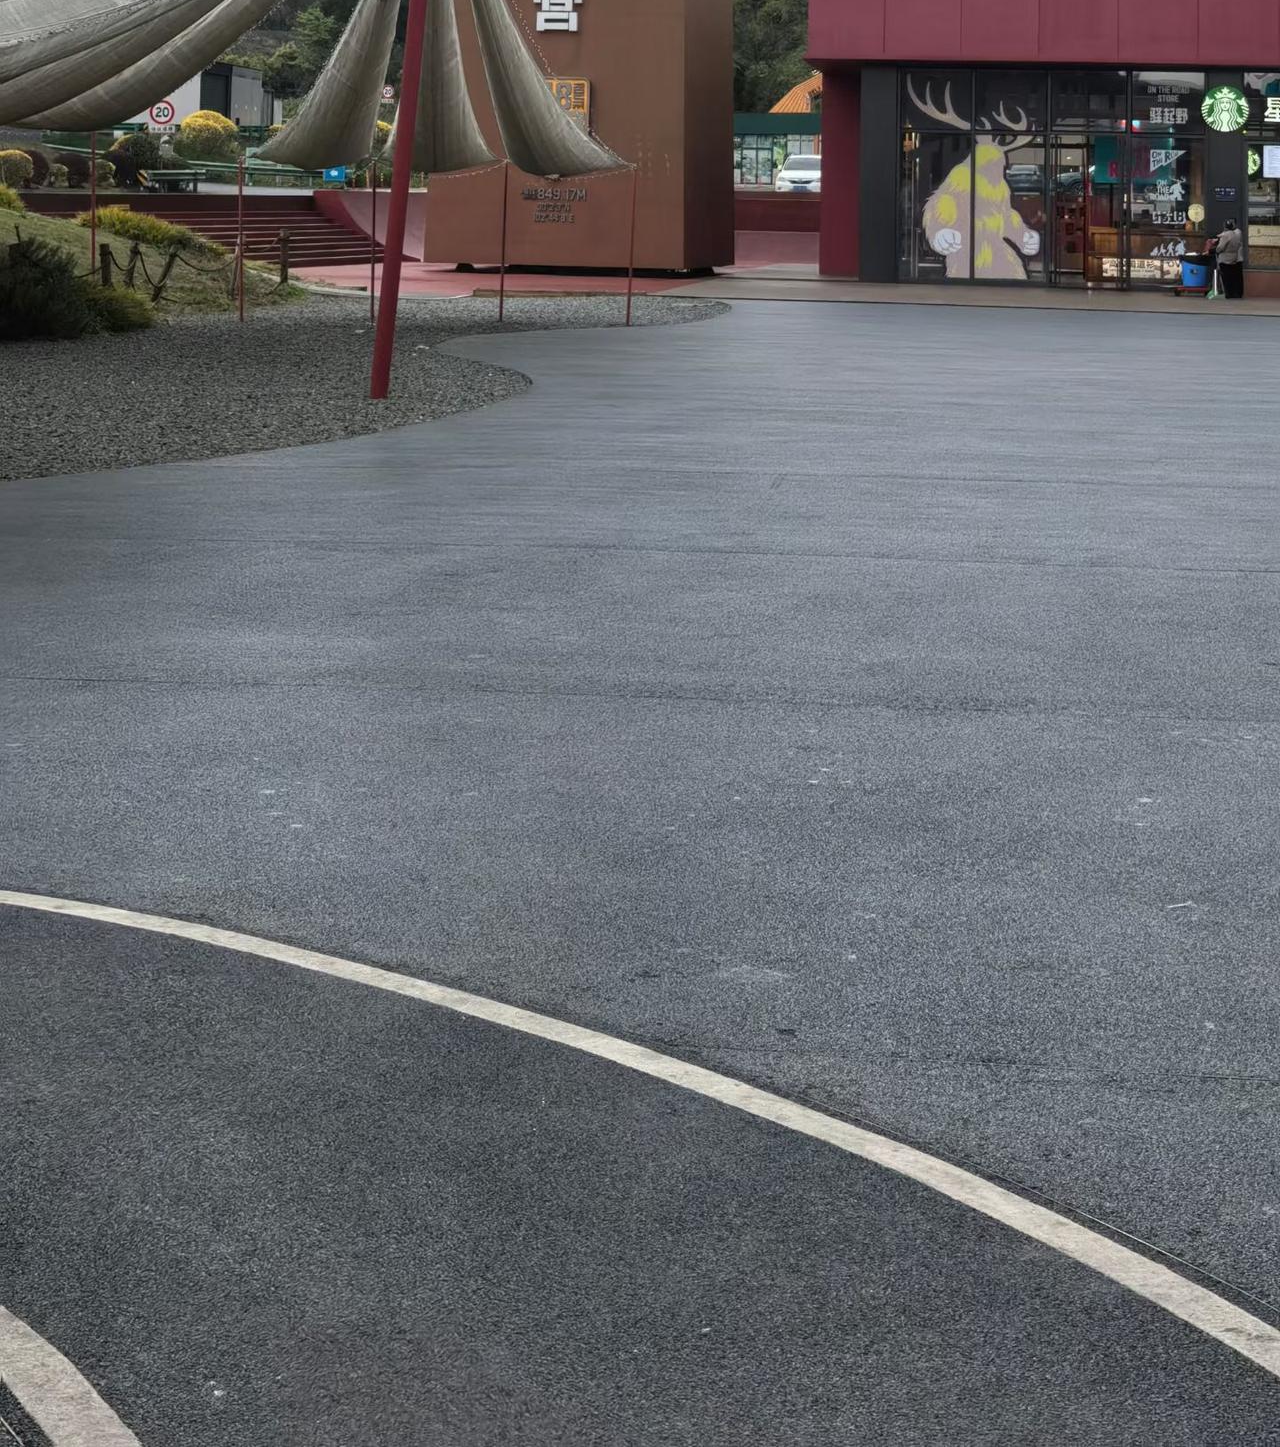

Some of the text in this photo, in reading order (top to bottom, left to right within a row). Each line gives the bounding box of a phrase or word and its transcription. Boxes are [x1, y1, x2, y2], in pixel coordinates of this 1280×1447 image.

[155, 106, 170, 118] 20
[1149, 107, 1188, 124] 驿起野
[1156, 186, 1170, 194] THE
